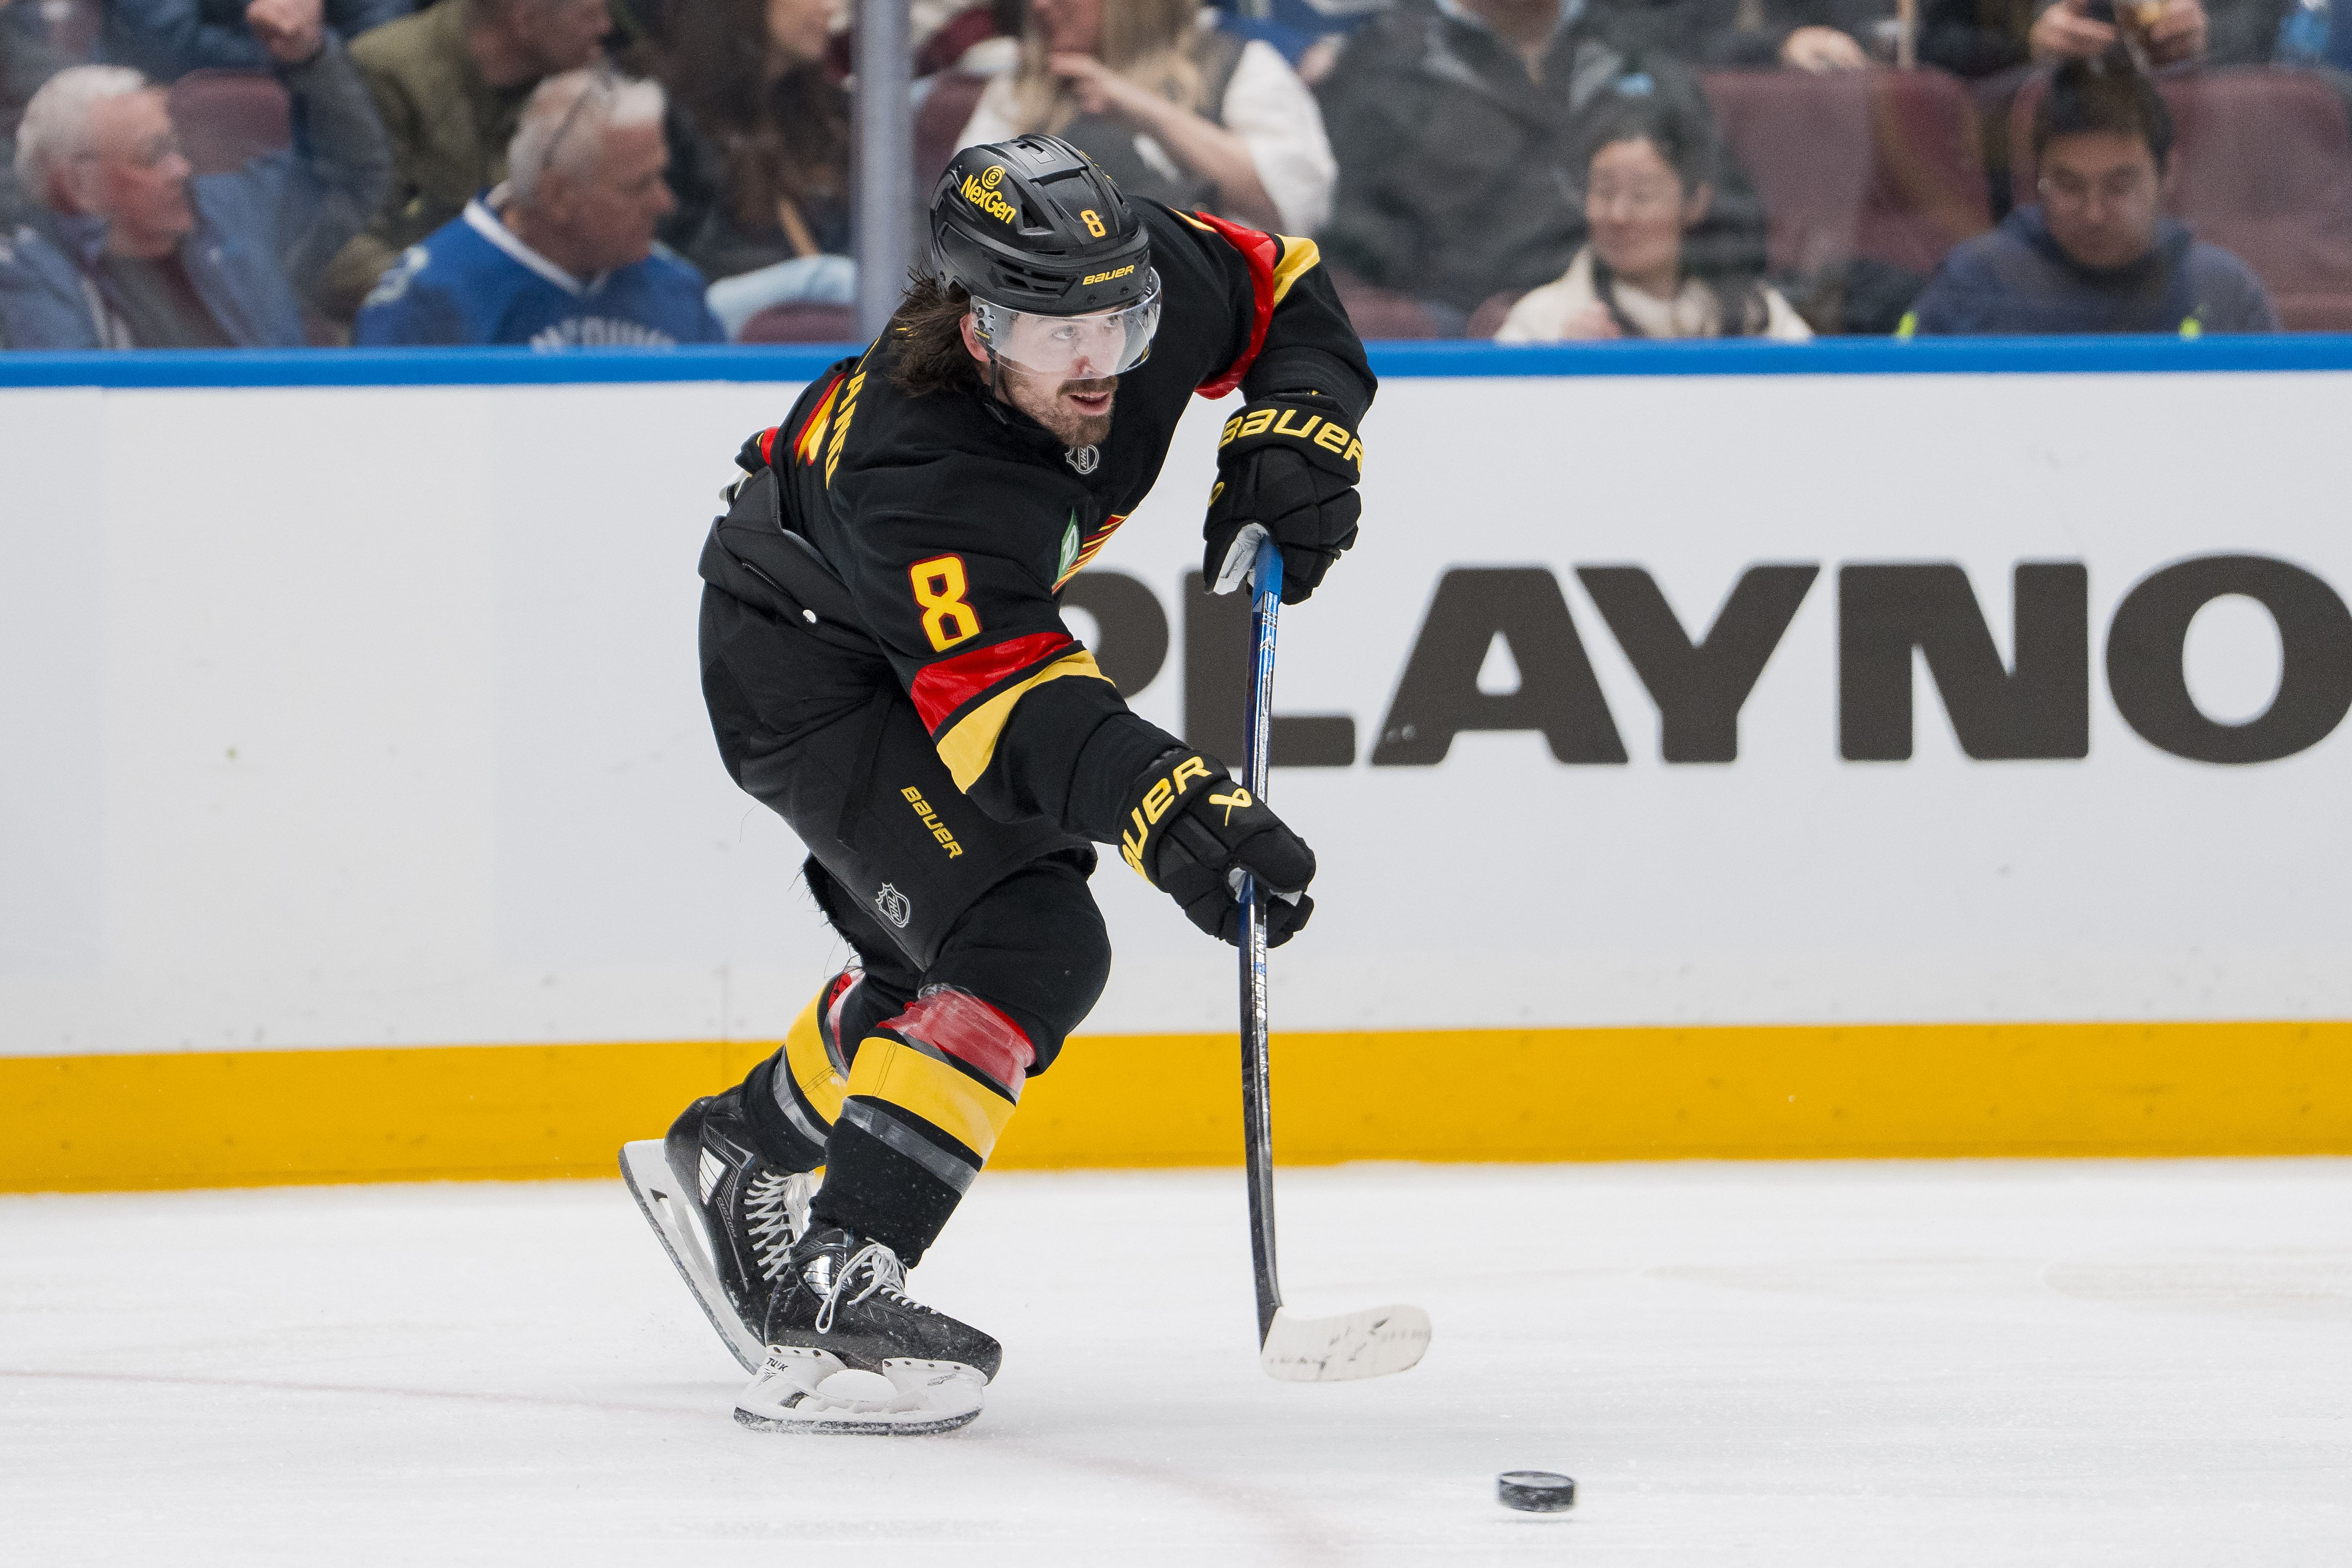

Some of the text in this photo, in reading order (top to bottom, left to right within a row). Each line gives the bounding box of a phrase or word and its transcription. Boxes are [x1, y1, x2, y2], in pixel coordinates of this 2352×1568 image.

[961, 174, 1016, 224] NexGen
[1080, 209, 1107, 237] 8
[1082, 264, 1134, 285] BAUER
[908, 553, 983, 653] 8
[900, 786, 962, 859] BAUER
[888, 895, 900, 922] NHL
[717, 1196, 737, 1238] CUSTOM
